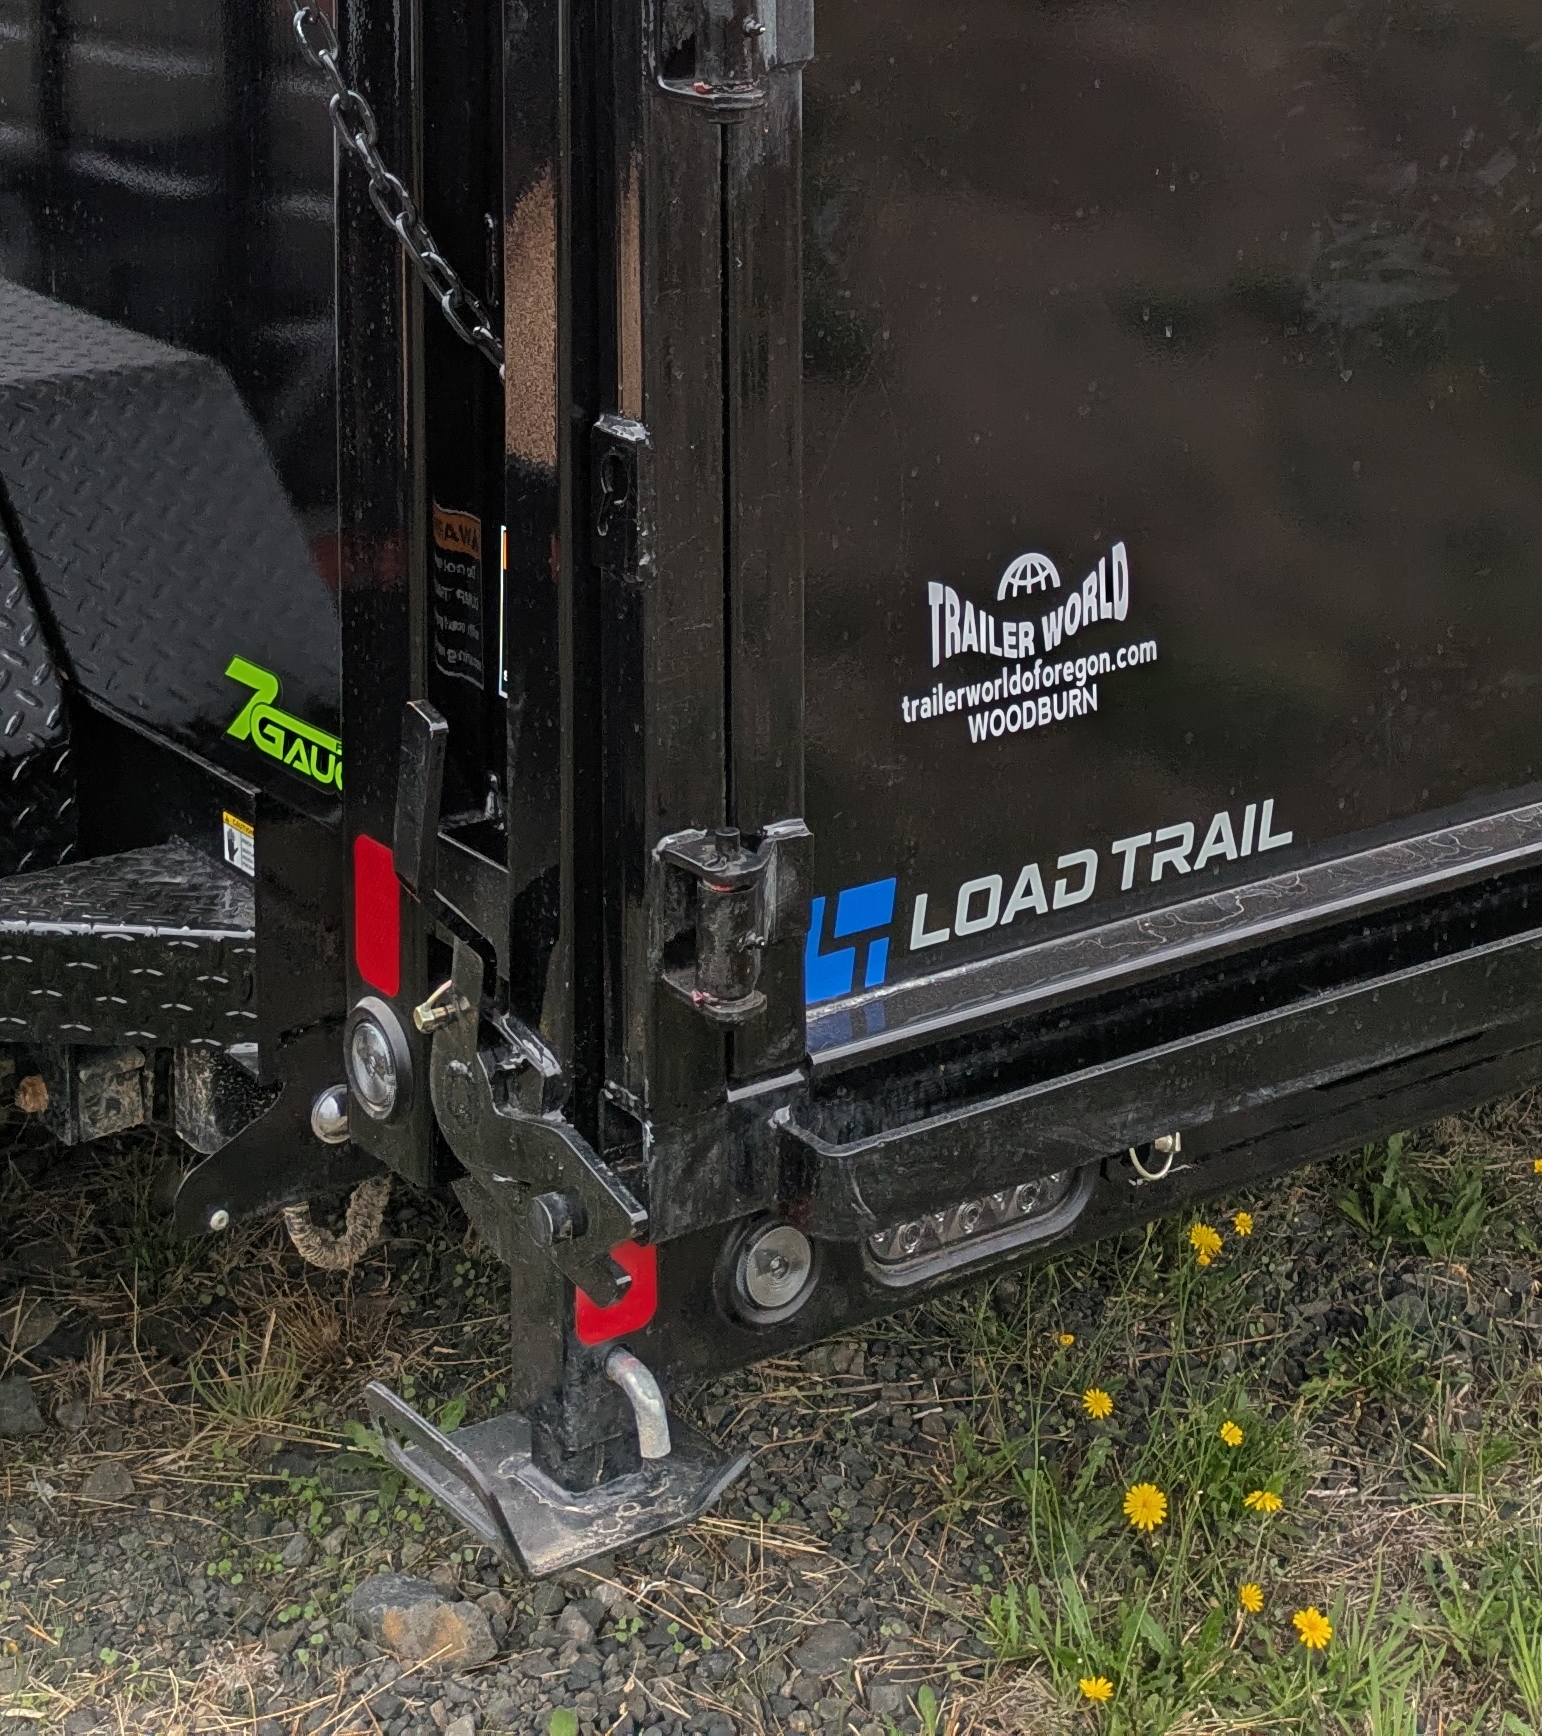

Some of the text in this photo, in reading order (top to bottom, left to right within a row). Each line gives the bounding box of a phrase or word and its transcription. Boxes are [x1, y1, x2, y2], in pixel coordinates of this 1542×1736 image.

[927, 541, 1130, 668] TRAILER WORLD
[224, 657, 279, 741] 7
[902, 640, 1158, 723] trailerworldoforegon.com
[968, 683, 1099, 743] WOODBURN
[250, 702, 343, 791] GAU
[909, 798, 1293, 951] LOAD TRAIL
